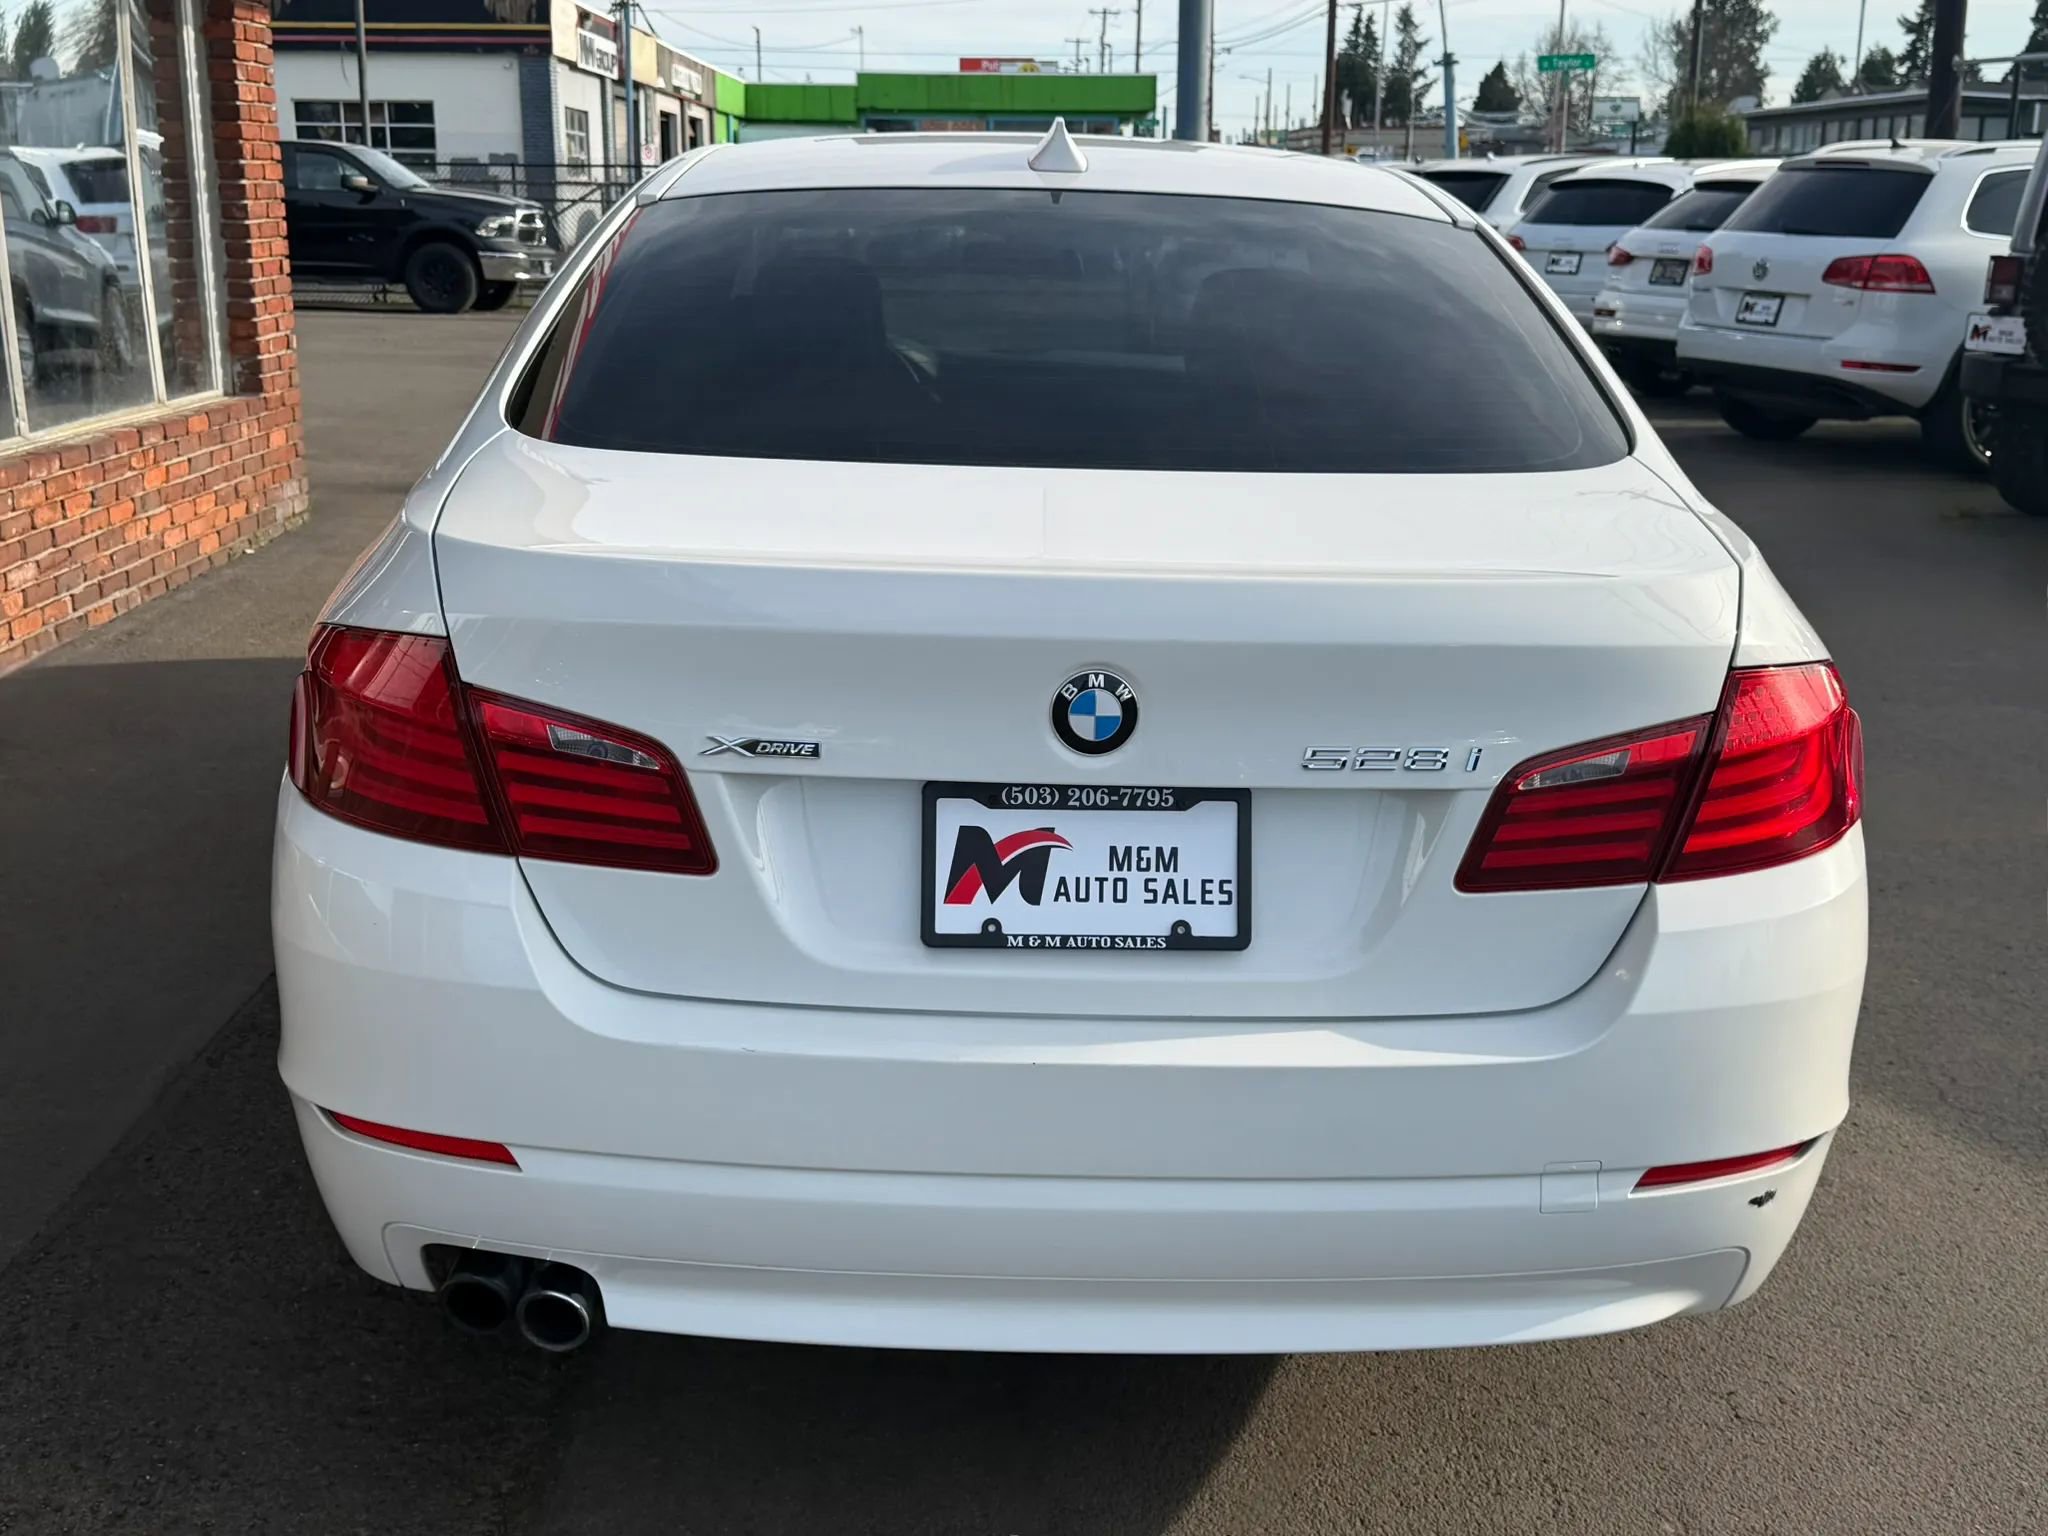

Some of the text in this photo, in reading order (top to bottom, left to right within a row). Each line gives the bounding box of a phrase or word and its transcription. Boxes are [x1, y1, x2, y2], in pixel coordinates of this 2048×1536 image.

[1552, 57, 1582, 71] Taylor
[1060, 673, 1133, 702] BMW
[1000, 786, 1175, 808] (503) 206-7795
[1108, 845, 1179, 874] M&M
[1053, 876, 1234, 906] AUTO SALES
[1006, 935, 1167, 950] M & M AUTO SALES
